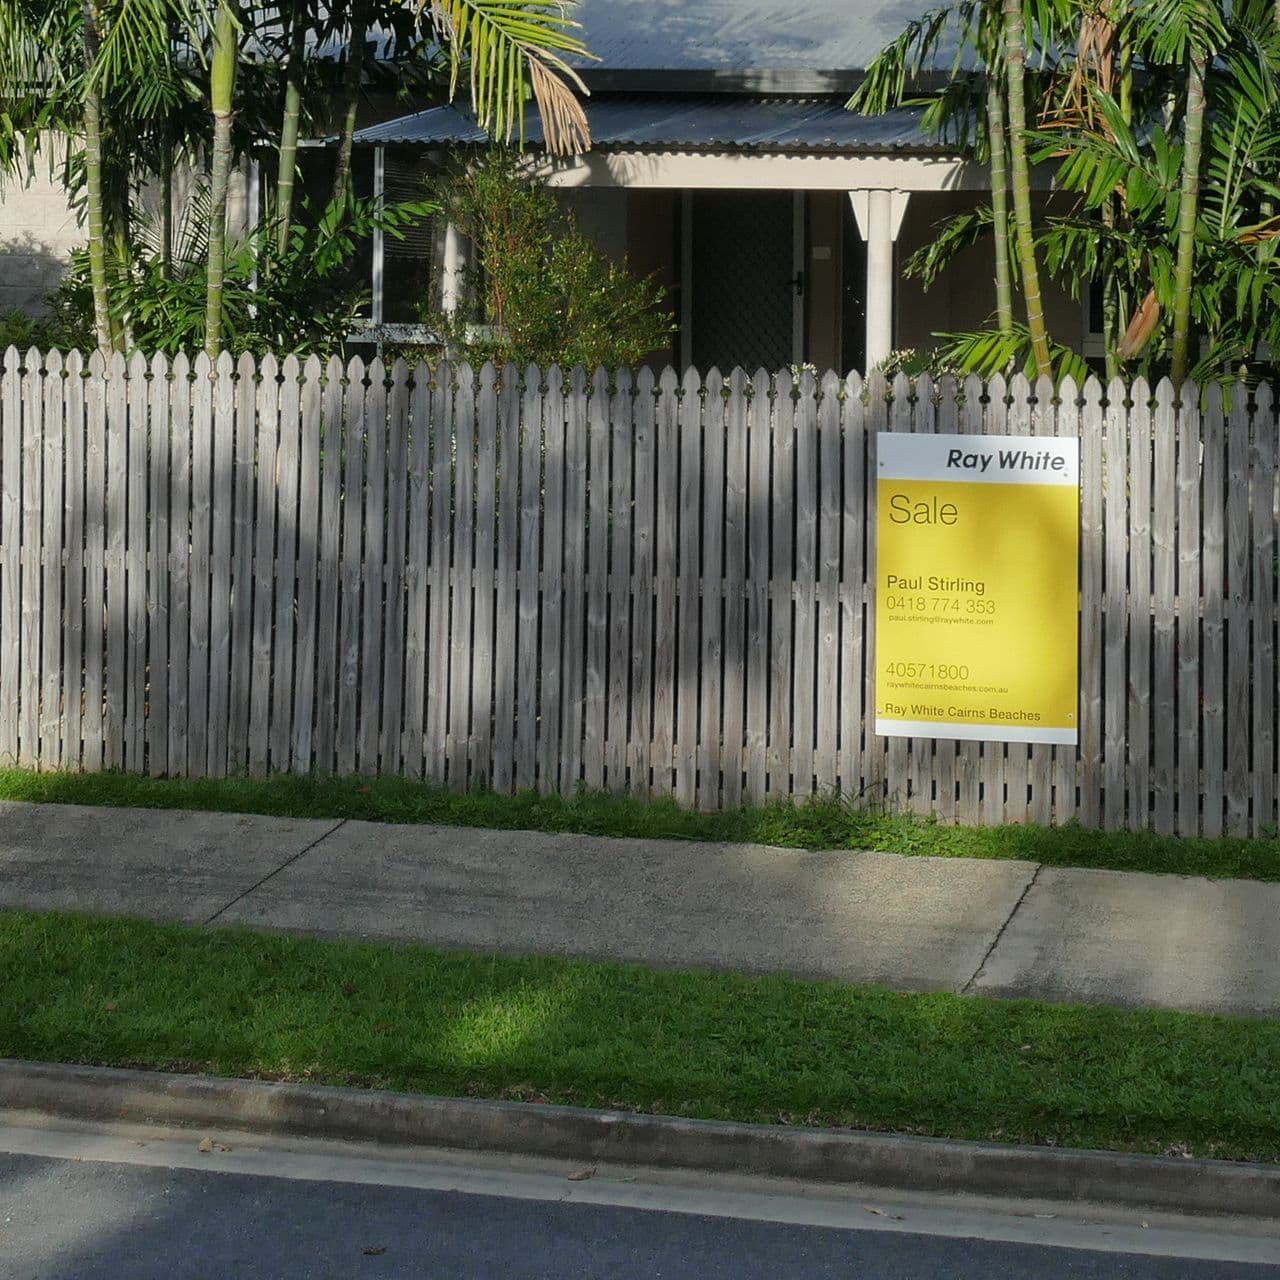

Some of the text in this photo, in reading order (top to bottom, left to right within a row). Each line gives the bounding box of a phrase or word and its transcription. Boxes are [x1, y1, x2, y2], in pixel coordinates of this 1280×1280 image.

[947, 449, 1065, 472] Ray White
[889, 494, 958, 525] Sale
[887, 575, 985, 596] Paul Stirling
[886, 595, 996, 614] 0418 774 353
[886, 662, 969, 680] 40571800
[885, 703, 1041, 721] Ray White Cairns Beaches
